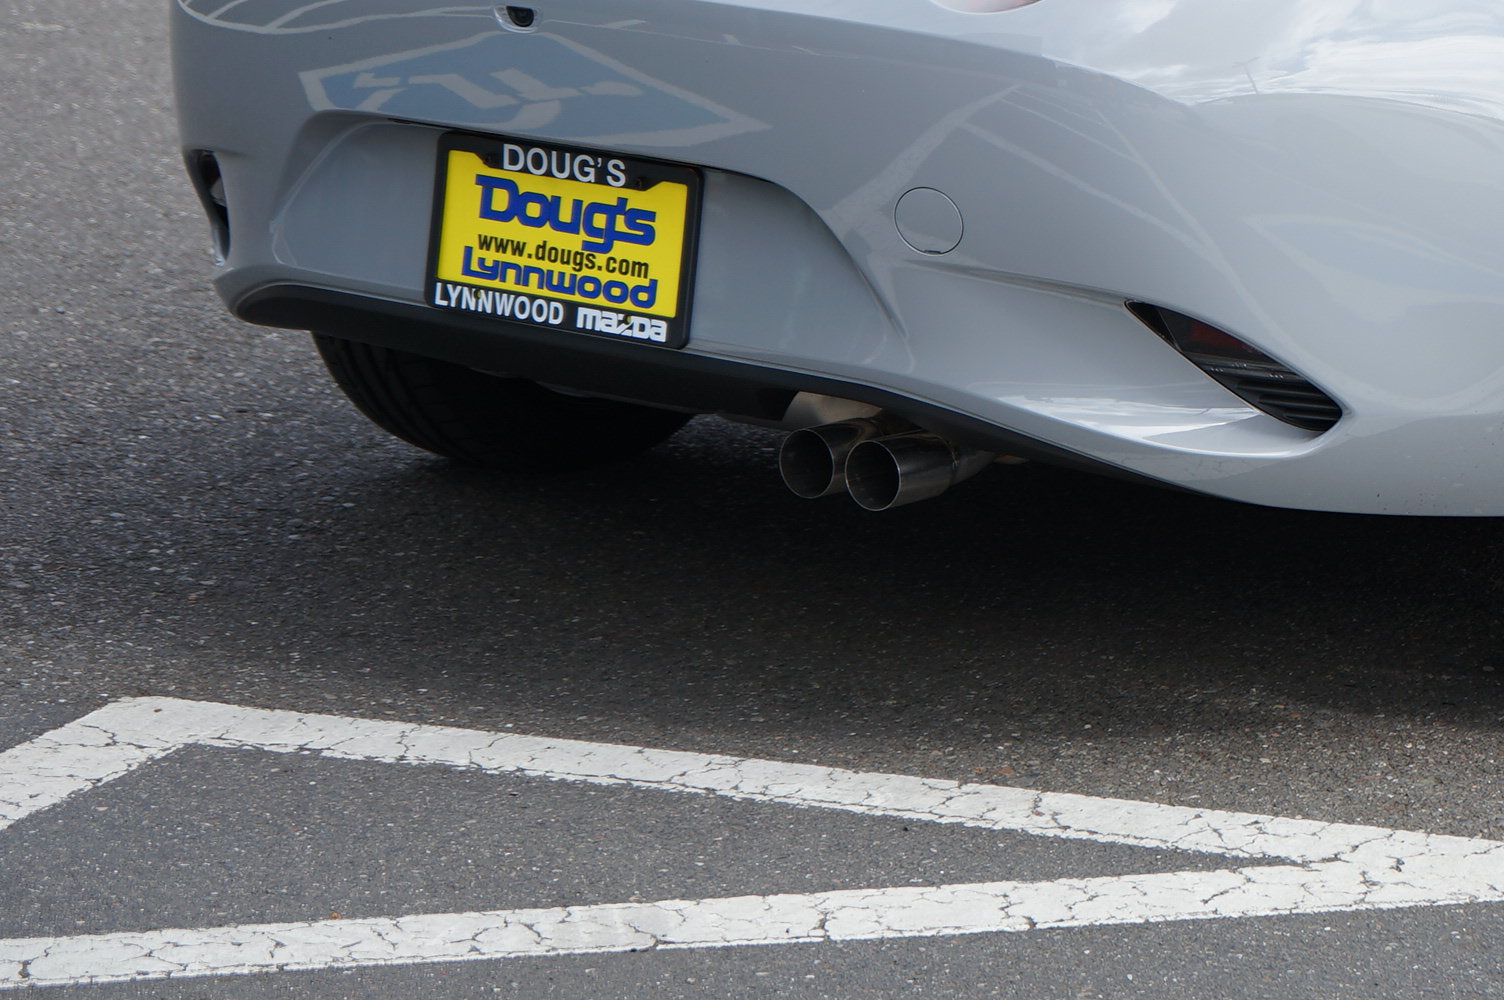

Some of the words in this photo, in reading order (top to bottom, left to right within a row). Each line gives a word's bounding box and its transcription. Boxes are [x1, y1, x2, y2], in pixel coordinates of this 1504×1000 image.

[503, 143, 627, 187] DOUG'S
[461, 245, 658, 309] Lynnwood
[477, 233, 650, 279] www.dougs.com
[434, 281, 564, 325] LYNNWOOD
